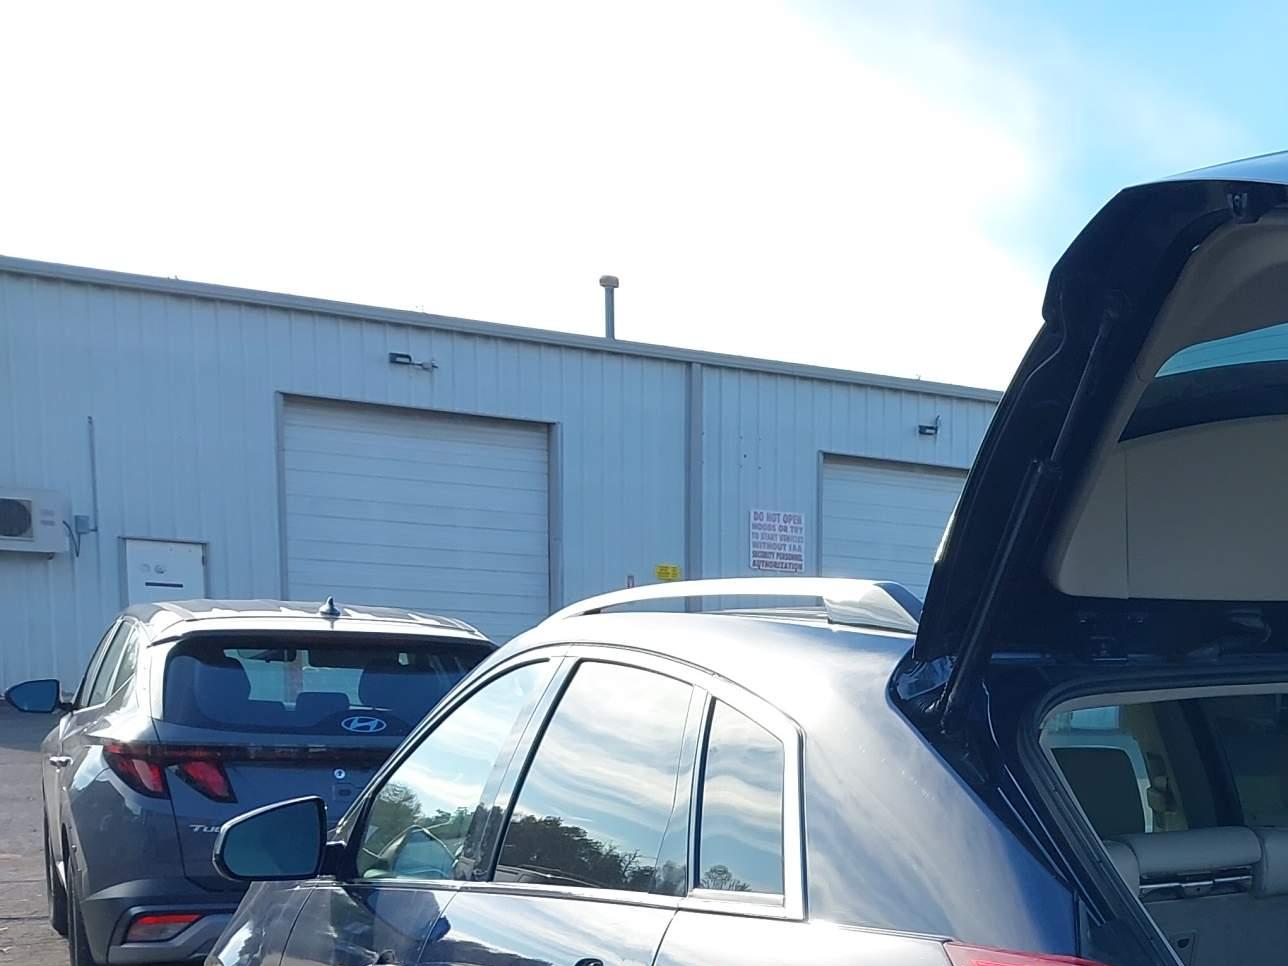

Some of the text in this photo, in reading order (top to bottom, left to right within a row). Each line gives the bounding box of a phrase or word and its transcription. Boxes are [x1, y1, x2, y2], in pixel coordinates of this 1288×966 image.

[753, 511, 802, 525] DO NOT OPEN
[778, 524, 788, 533] OR
[790, 525, 803, 534] TRY
[752, 532, 759, 540] TO
[752, 541, 802, 552] WITHOUT IAA
[752, 550, 775, 559] SECURITY
[752, 560, 803, 570] AUTHORIZATION
